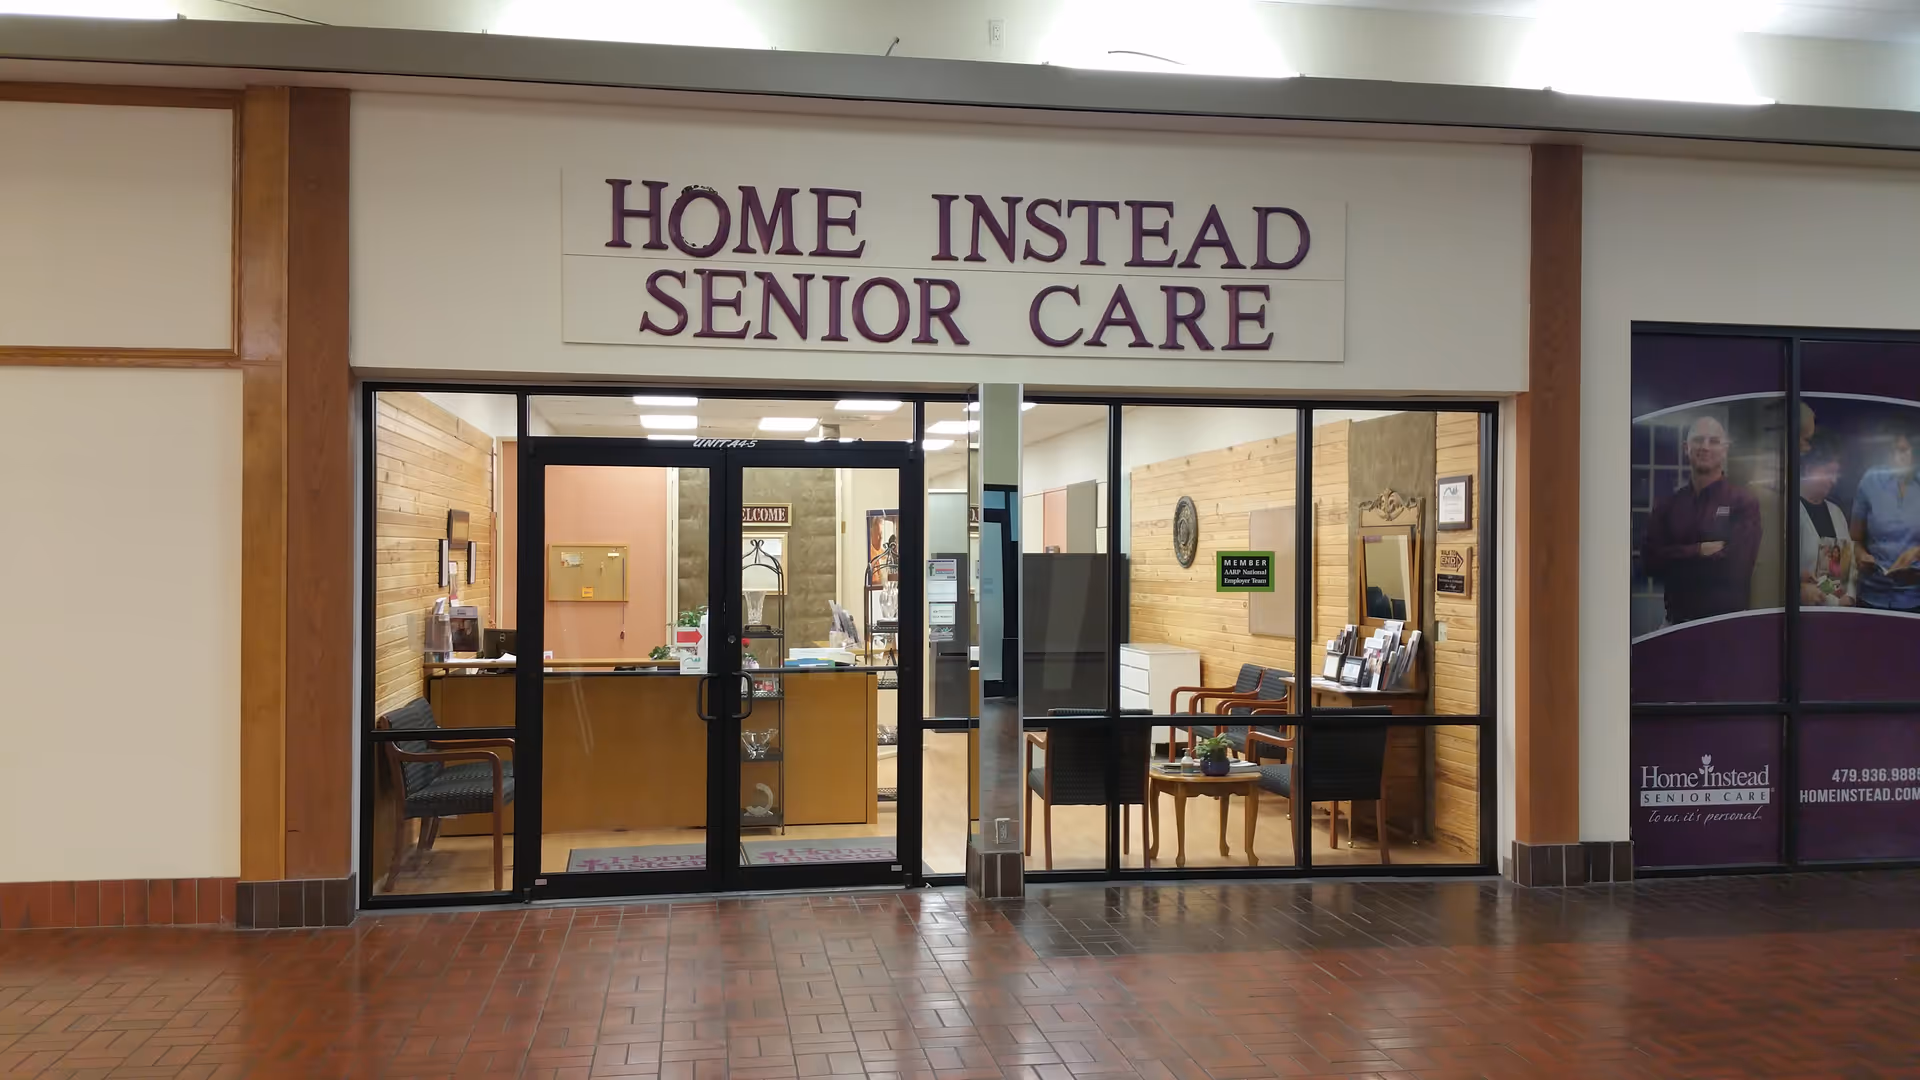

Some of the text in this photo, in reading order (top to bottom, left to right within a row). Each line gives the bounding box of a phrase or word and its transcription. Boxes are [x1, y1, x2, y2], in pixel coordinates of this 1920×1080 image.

[605, 179, 1311, 270] HOME INSTEAD
[639, 268, 1274, 351] SENIOR CARE
[693, 439, 731, 448] UNIT
[1223, 559, 1267, 567] MEMBER
[1440, 556, 1457, 564] END
[1223, 577, 1250, 585] Employer
[1640, 764, 1770, 788] Home Instead
[1643, 790, 1767, 804] SENIOR CARE
[1799, 787, 1920, 803] HOMEINSTEAD.COM
[1648, 809, 1661, 823] To
[1683, 808, 1702, 822] it's
